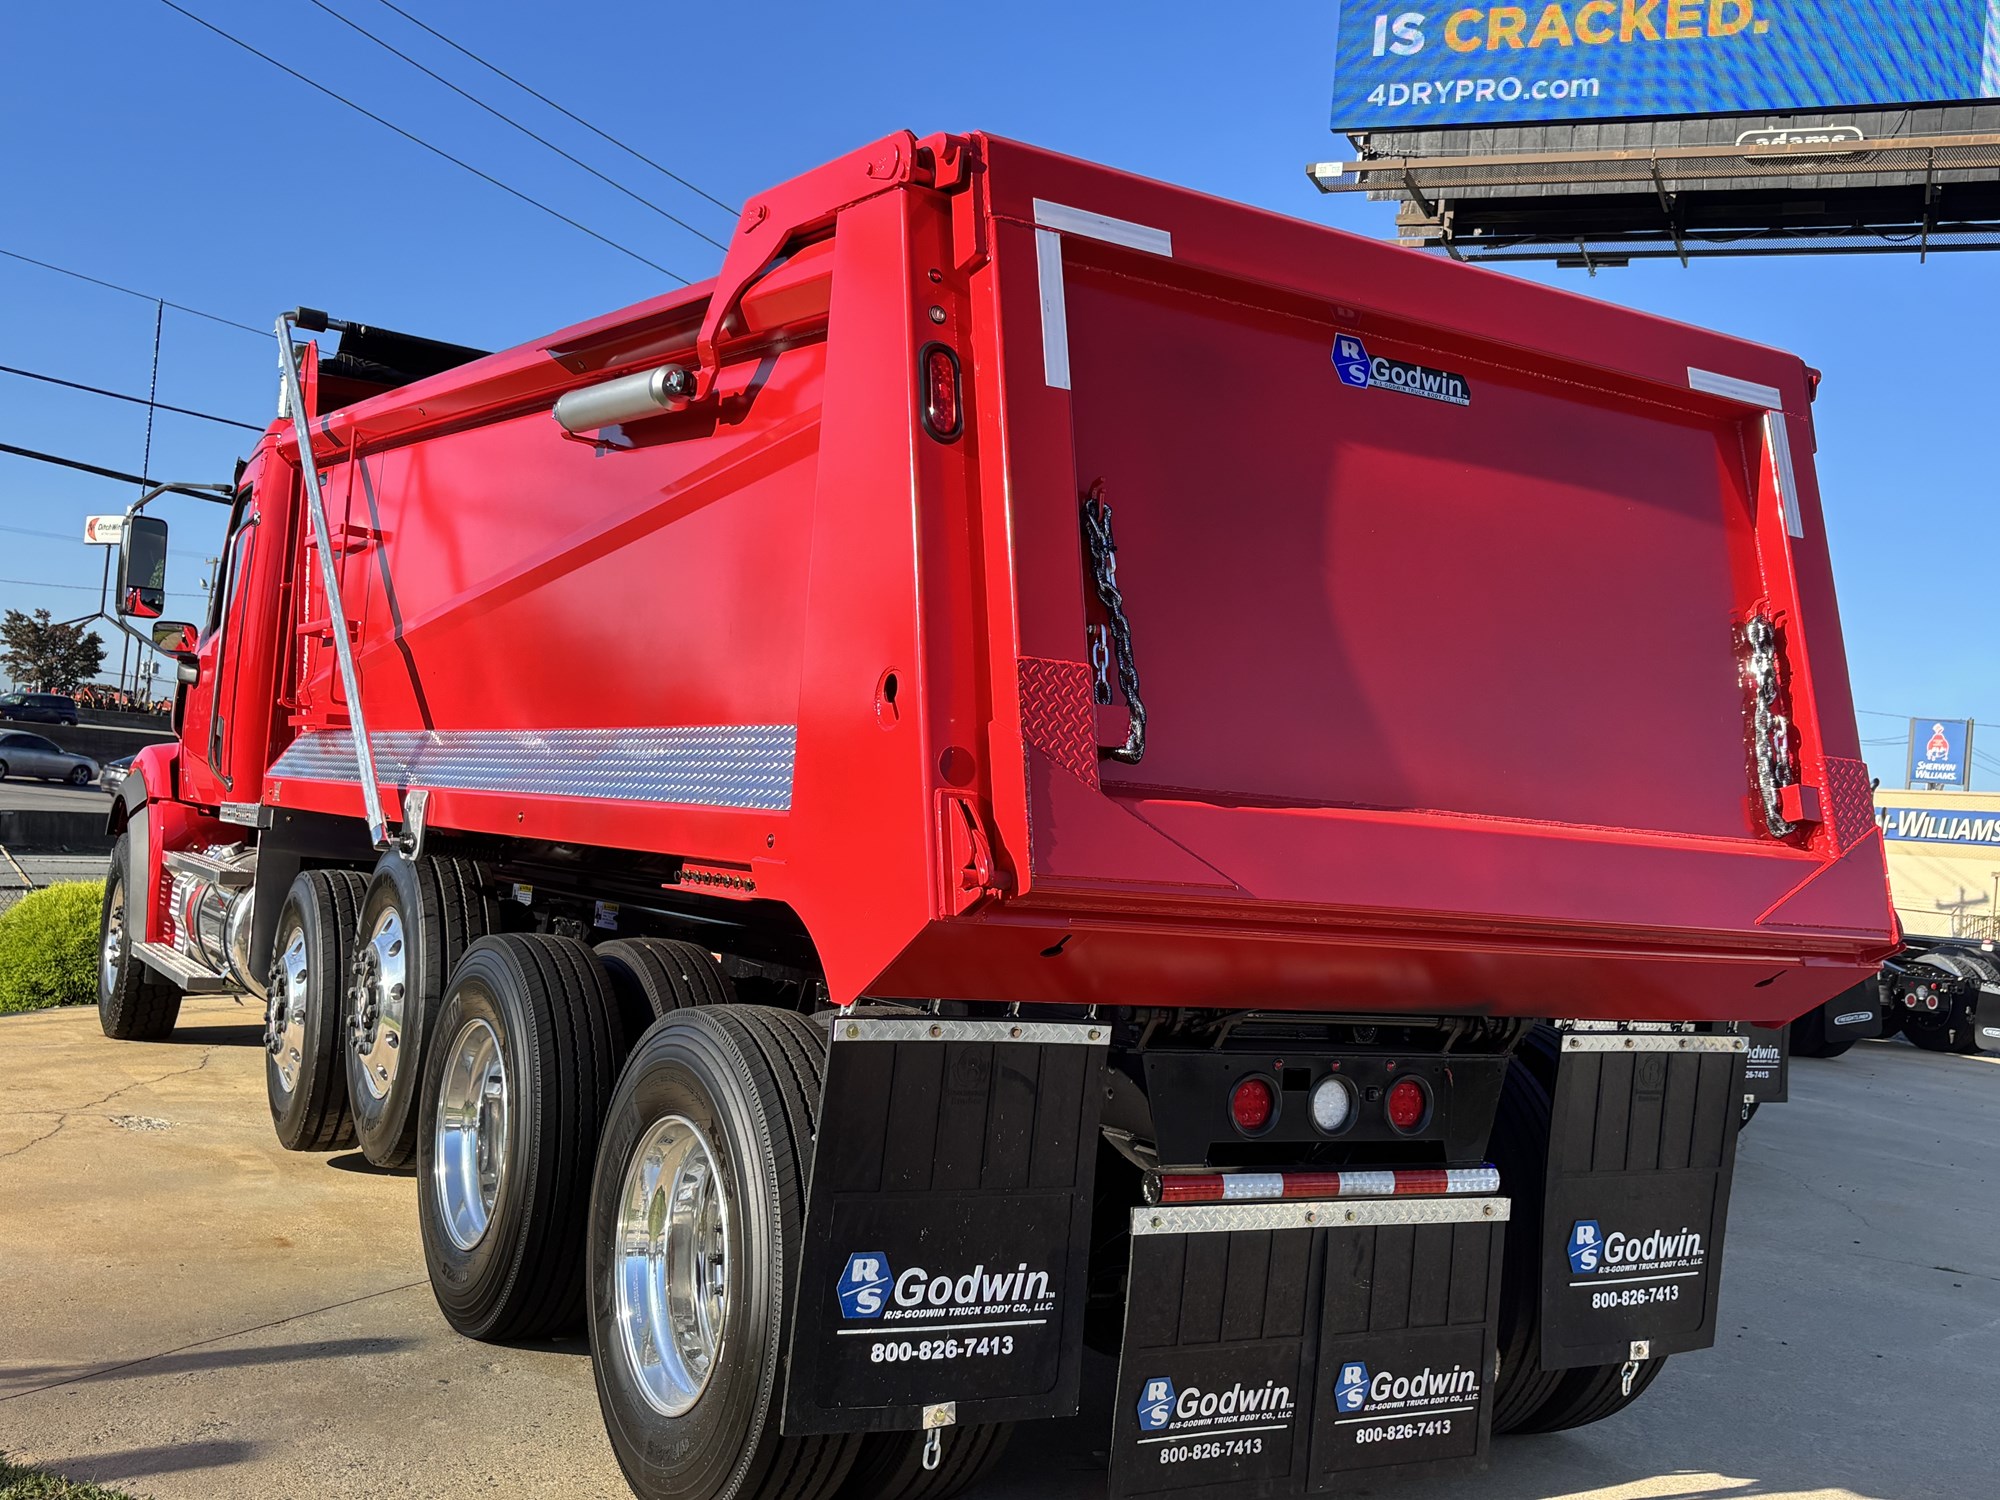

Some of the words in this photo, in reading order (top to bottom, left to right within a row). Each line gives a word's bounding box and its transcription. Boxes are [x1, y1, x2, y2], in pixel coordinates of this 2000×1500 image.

[1372, 13, 1426, 57] IS
[1443, 0, 1770, 53] CRACKED.
[1366, 76, 1600, 108] 4DRYPRO.com
[1371, 357, 1462, 398] Godwin
[1916, 761, 1957, 771] SHERWIN
[1604, 1227, 1700, 1263] Godwin
[1638, 1262, 1659, 1270] TRUCK
[1659, 1260, 1676, 1268] BODY
[894, 1263, 1049, 1307] Godwin
[1592, 1285, 1679, 1309] 800-826-7413
[884, 1308, 945, 1320] R/S-GODWIN
[948, 1305, 981, 1317] TRUCK
[983, 1304, 1010, 1315] BODY
[1012, 1303, 1032, 1313] CO.,
[1034, 1302, 1055, 1312] LLC.
[870, 1336, 1014, 1363] 800-826-7413
[1370, 1365, 1475, 1401] Godwin
[1176, 1380, 1290, 1419] Godwin
[1363, 1402, 1405, 1411] R/S-GODWIN
[1406, 1399, 1428, 1407] TRUCK
[1429, 1397, 1449, 1405] BODY
[1169, 1418, 1212, 1430] R/S-GODWIN
[1213, 1415, 1239, 1424] TRUCK
[1239, 1413, 1260, 1422] BODY
[1356, 1419, 1451, 1444] 800-826-7413
[1159, 1438, 1263, 1464] 800-826-7413
